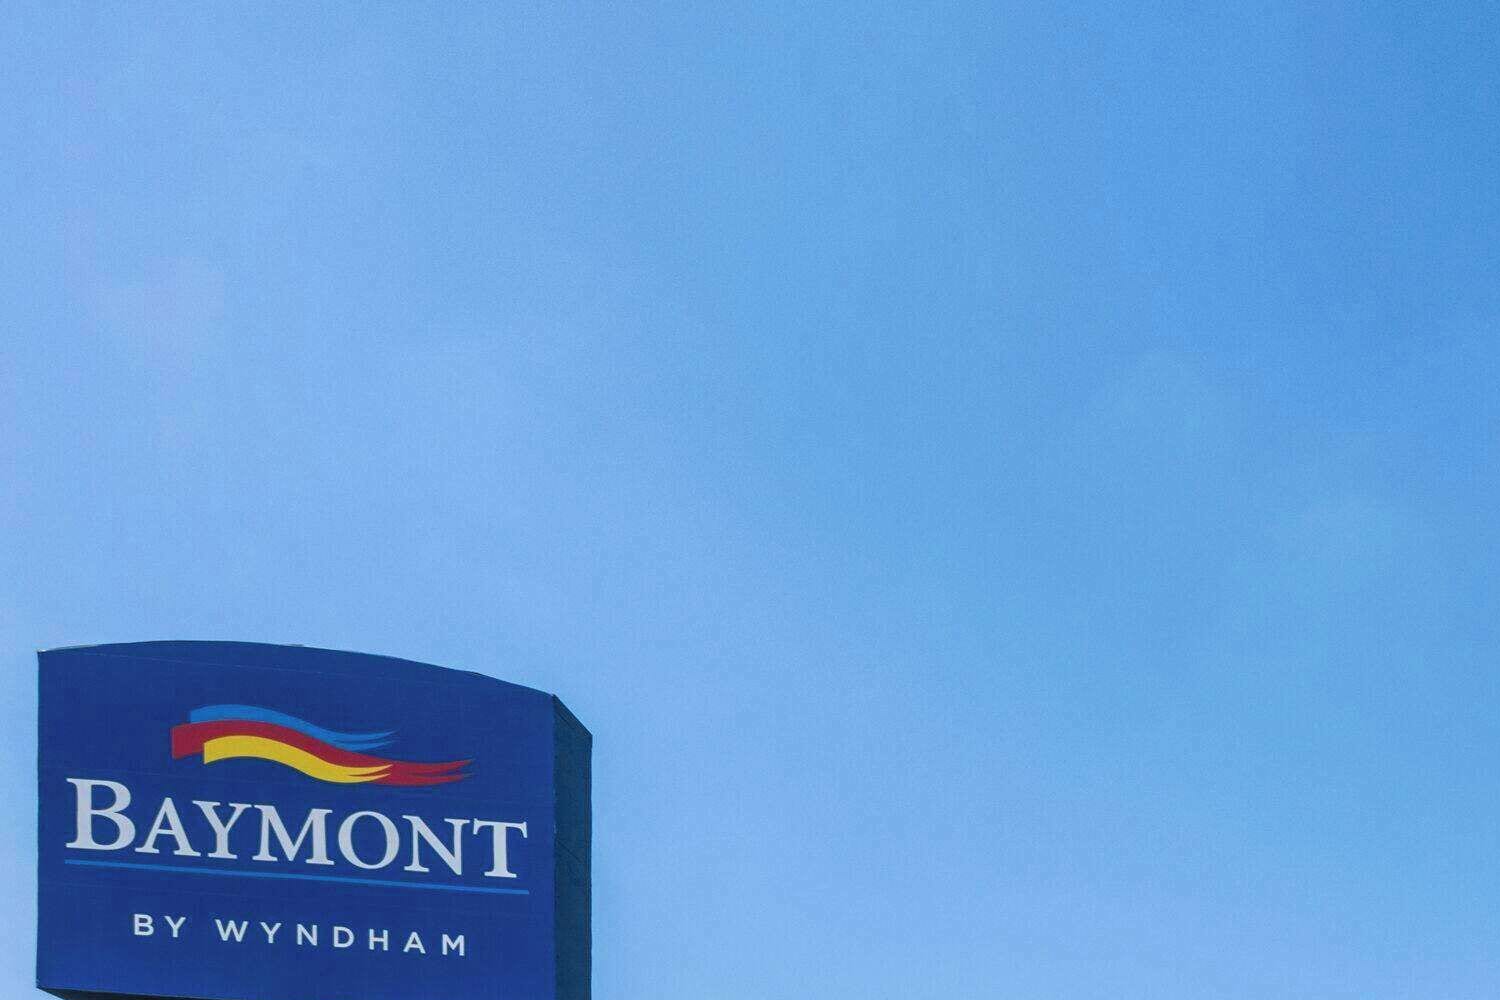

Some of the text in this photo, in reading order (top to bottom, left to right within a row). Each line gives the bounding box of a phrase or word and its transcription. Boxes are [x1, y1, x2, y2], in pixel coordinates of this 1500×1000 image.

[66, 778, 527, 878] BAYMONT
[133, 914, 466, 956] BY WYNDHAM
